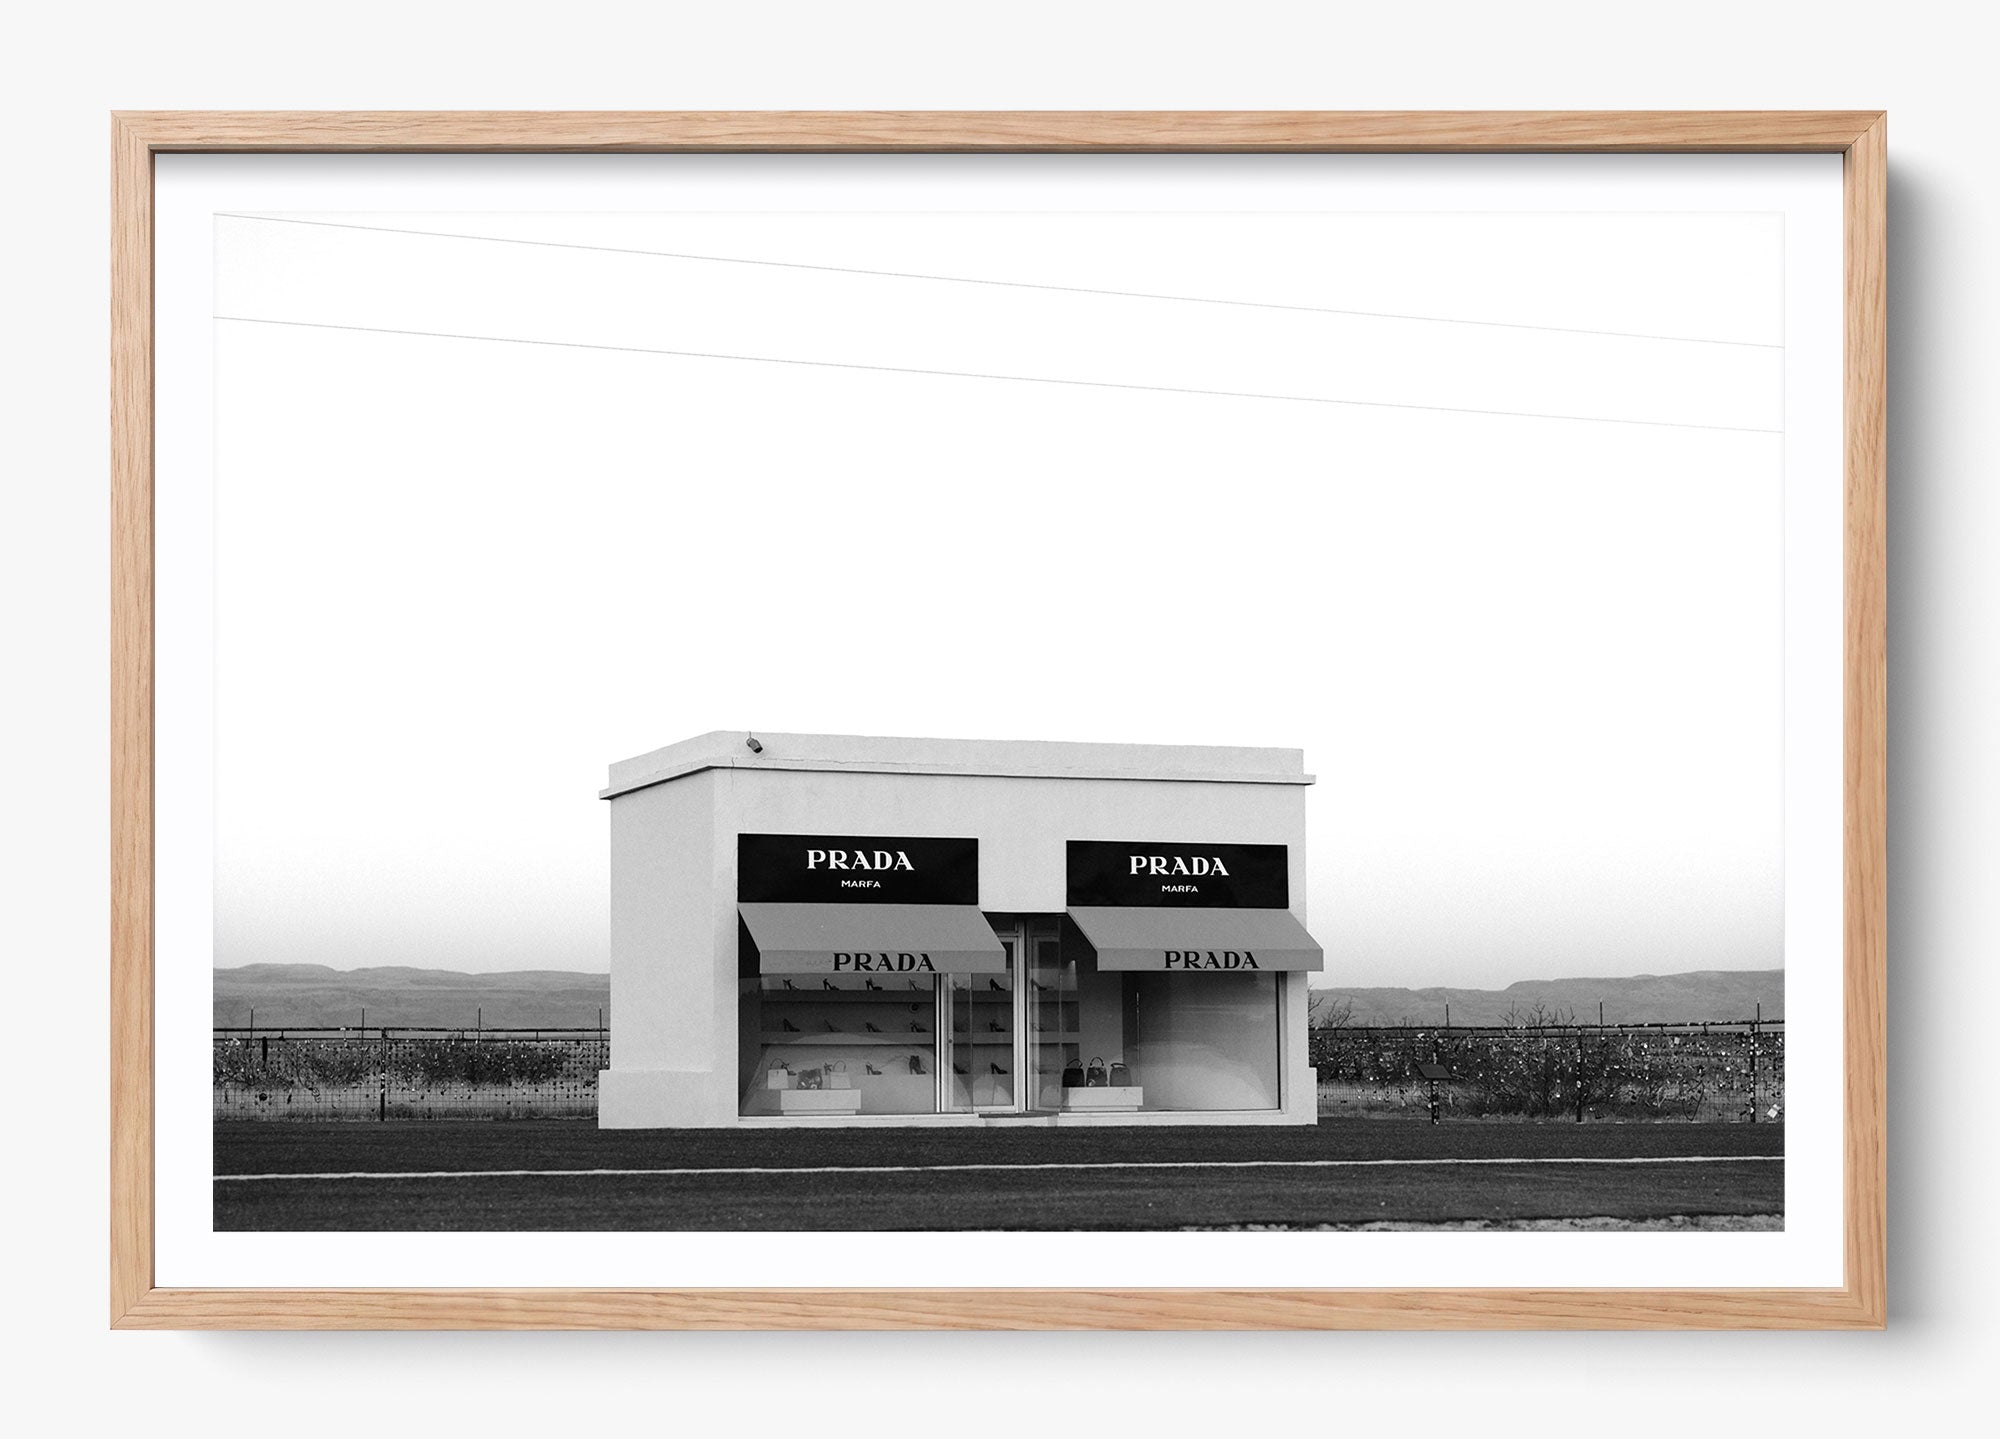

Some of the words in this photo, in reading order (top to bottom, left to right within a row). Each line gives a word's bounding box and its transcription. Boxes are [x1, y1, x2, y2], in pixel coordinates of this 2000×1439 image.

[806, 849, 915, 871] PRADA
[1129, 855, 1230, 876] PRADA
[841, 879, 882, 889] MARFA
[1161, 884, 1199, 893] MARFA
[833, 952, 936, 972] PRADA
[1163, 951, 1260, 969] PRADA
